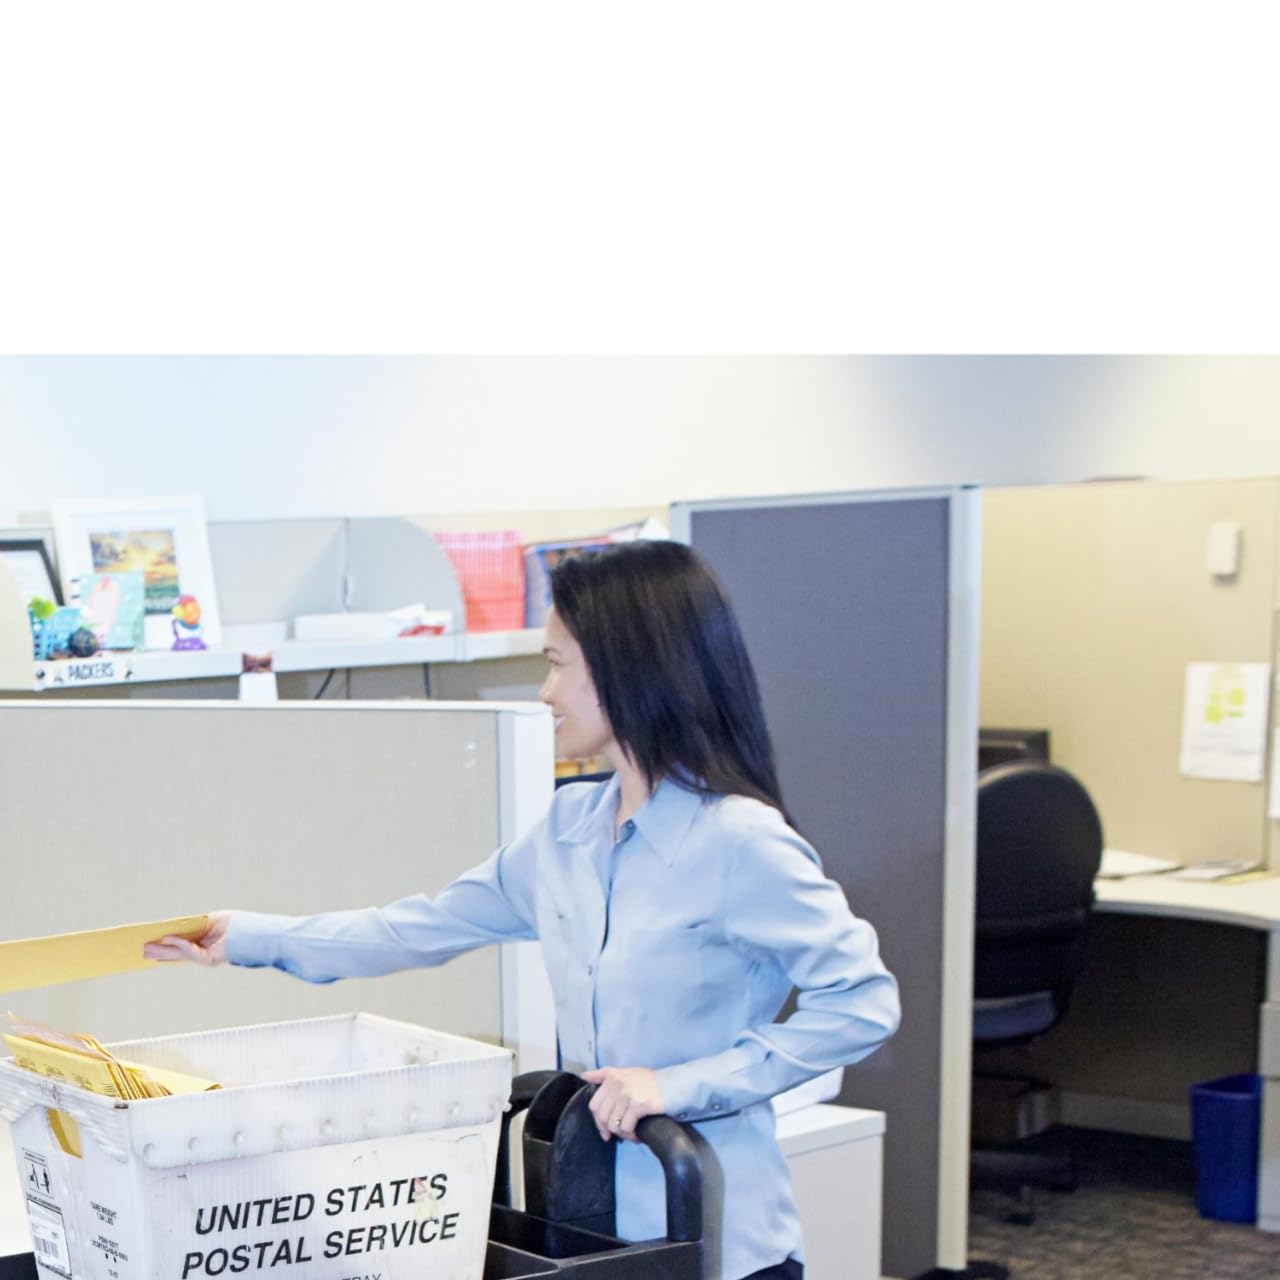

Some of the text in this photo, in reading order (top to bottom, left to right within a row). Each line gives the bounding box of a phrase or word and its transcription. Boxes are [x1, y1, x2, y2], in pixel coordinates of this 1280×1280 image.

[68, 662, 115, 679] PACKERS
[195, 1173, 448, 1235] UNITED STATES
[181, 1237, 312, 1280] POSTAL
[323, 1212, 460, 1259] SERVICE
